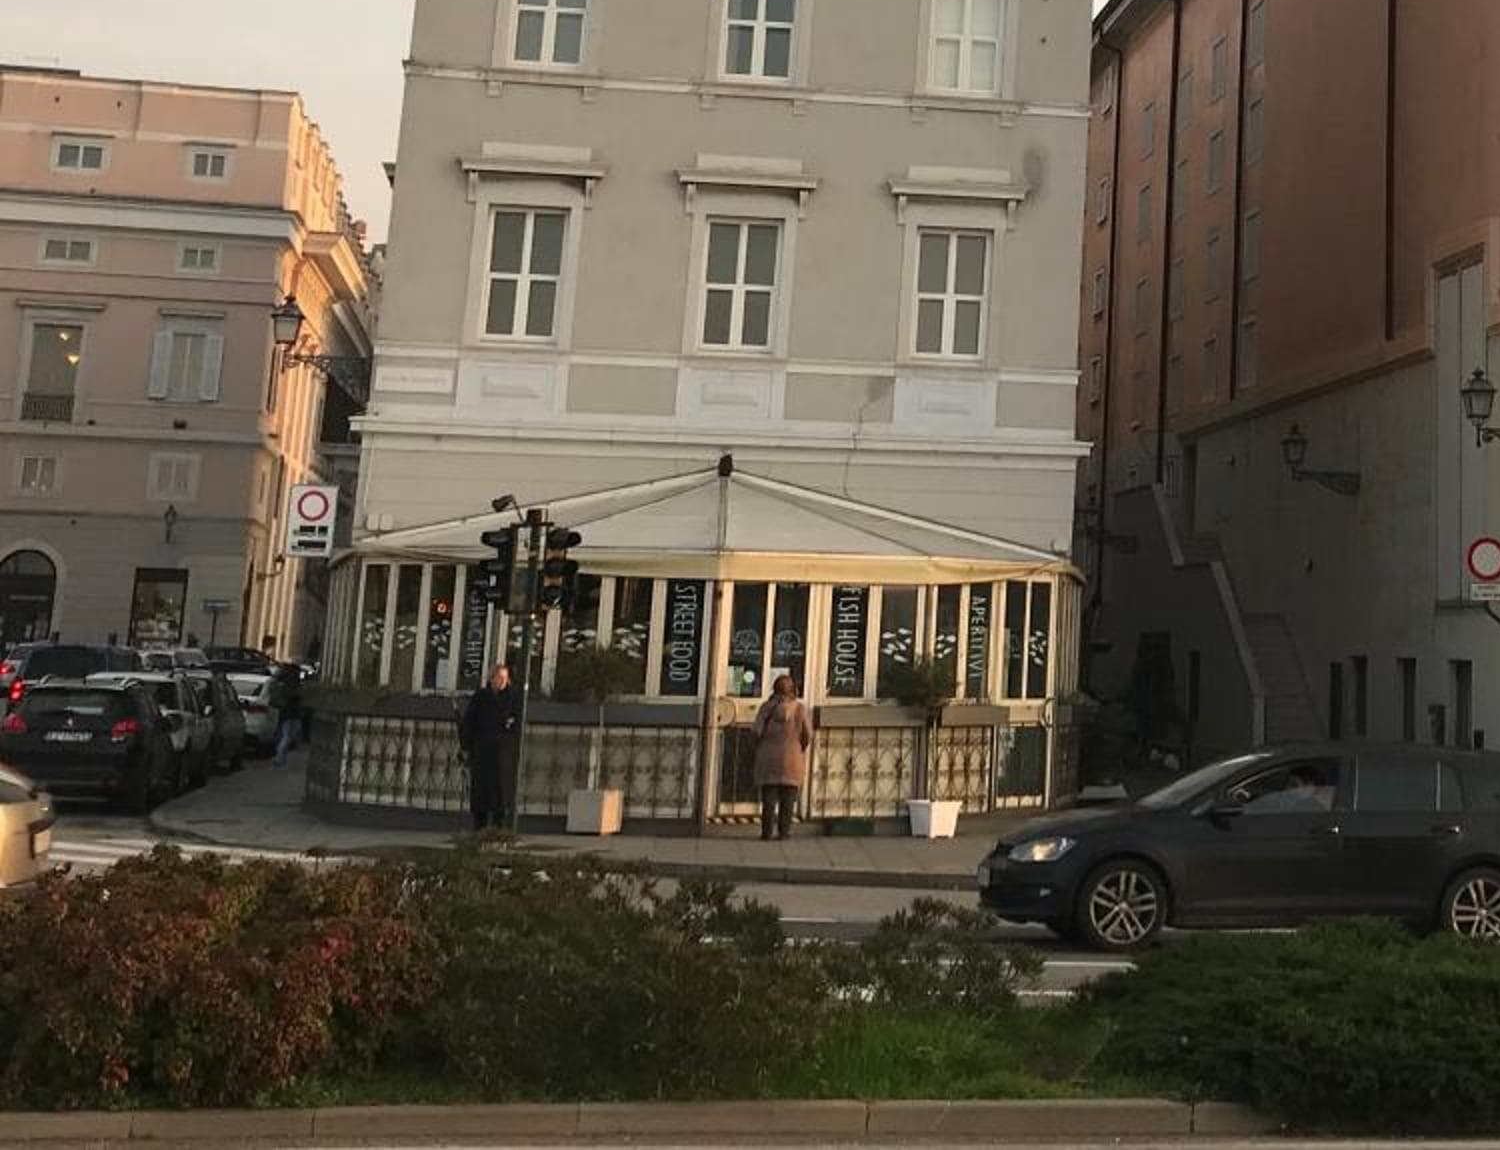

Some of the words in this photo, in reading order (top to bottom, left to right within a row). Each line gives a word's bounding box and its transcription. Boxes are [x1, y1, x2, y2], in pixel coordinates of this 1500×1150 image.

[672, 583, 698, 638] STREET
[838, 586, 862, 621] FISH
[668, 640, 694, 682] FOOD
[833, 629, 859, 687] HOUSE
